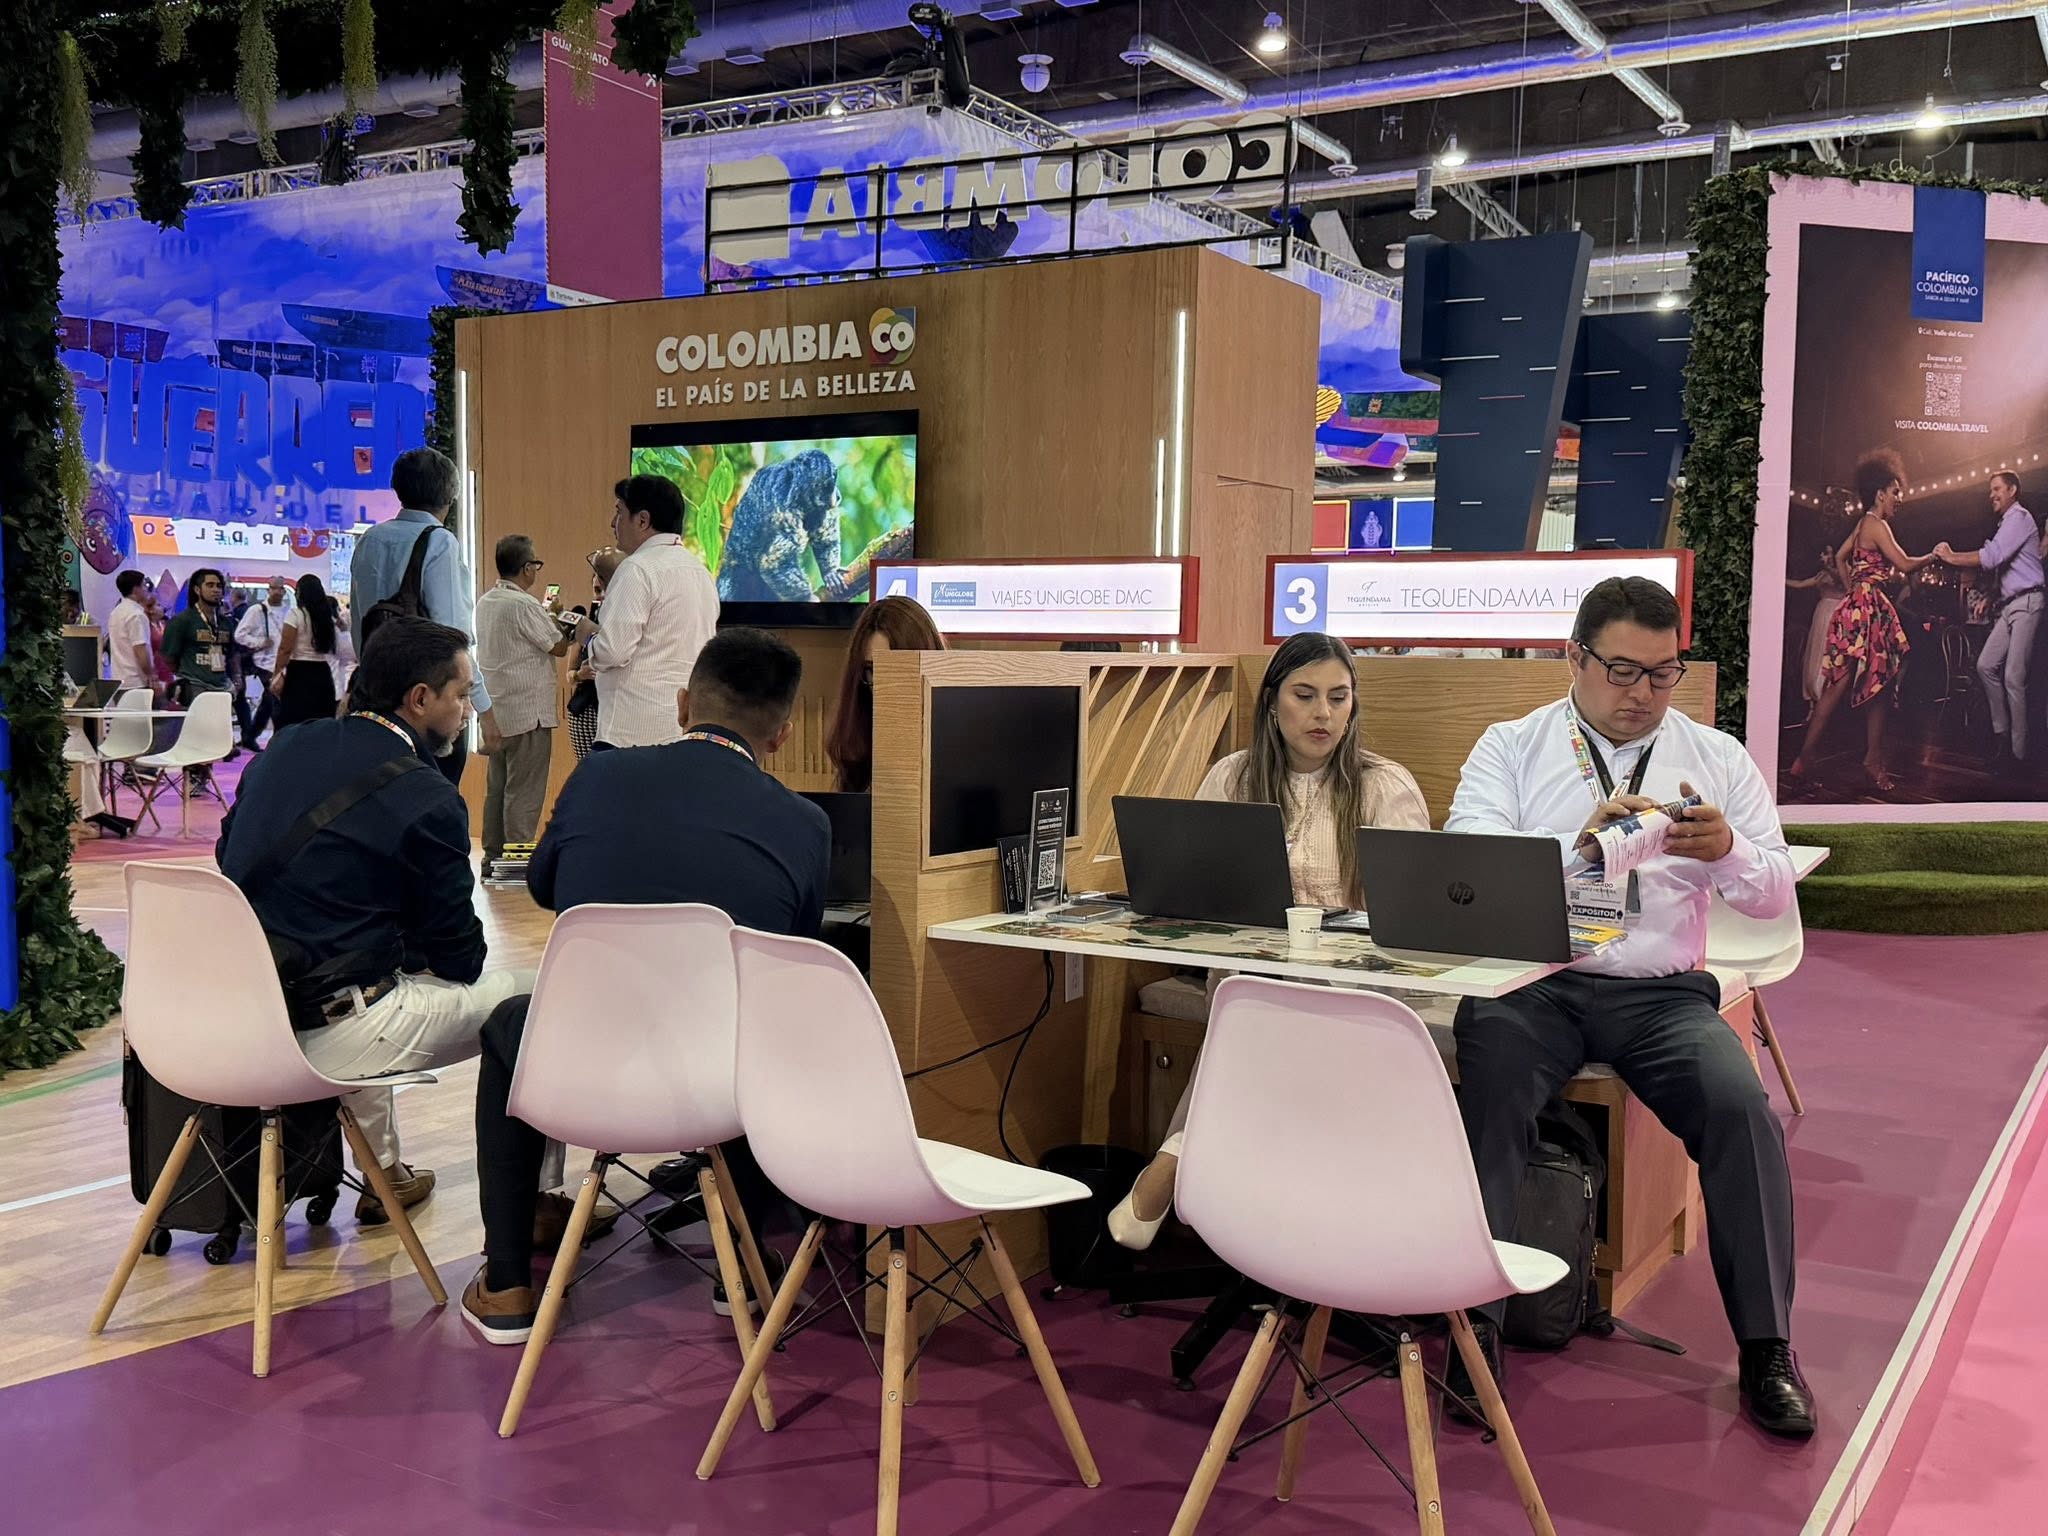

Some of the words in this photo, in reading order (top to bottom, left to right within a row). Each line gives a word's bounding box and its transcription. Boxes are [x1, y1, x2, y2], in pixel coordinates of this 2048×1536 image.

[1926, 270, 1970, 284] PACÍFICO
[1916, 281, 1979, 296] COLOMBIANO
[656, 320, 863, 374] COLOMBIA
[871, 322, 915, 354] CO
[656, 388, 677, 408] EL
[686, 377, 734, 405] PAÍS
[744, 380, 769, 402] DE
[780, 378, 807, 400] LA
[817, 370, 917, 398] BELLEZA
[1895, 420, 1916, 430] VISITA
[1917, 421, 1990, 433] COLOMBIA.TRAVEL
[991, 589, 1032, 607] VIAJES
[1036, 589, 1110, 606] UNIGLOBE
[1115, 589, 1153, 605] DMC
[1284, 577, 1318, 625] 3
[1401, 587, 1555, 608] TEQUENDAMA
[1452, 881, 1472, 906] hp
[1572, 906, 1617, 918] EXPOSITOR
